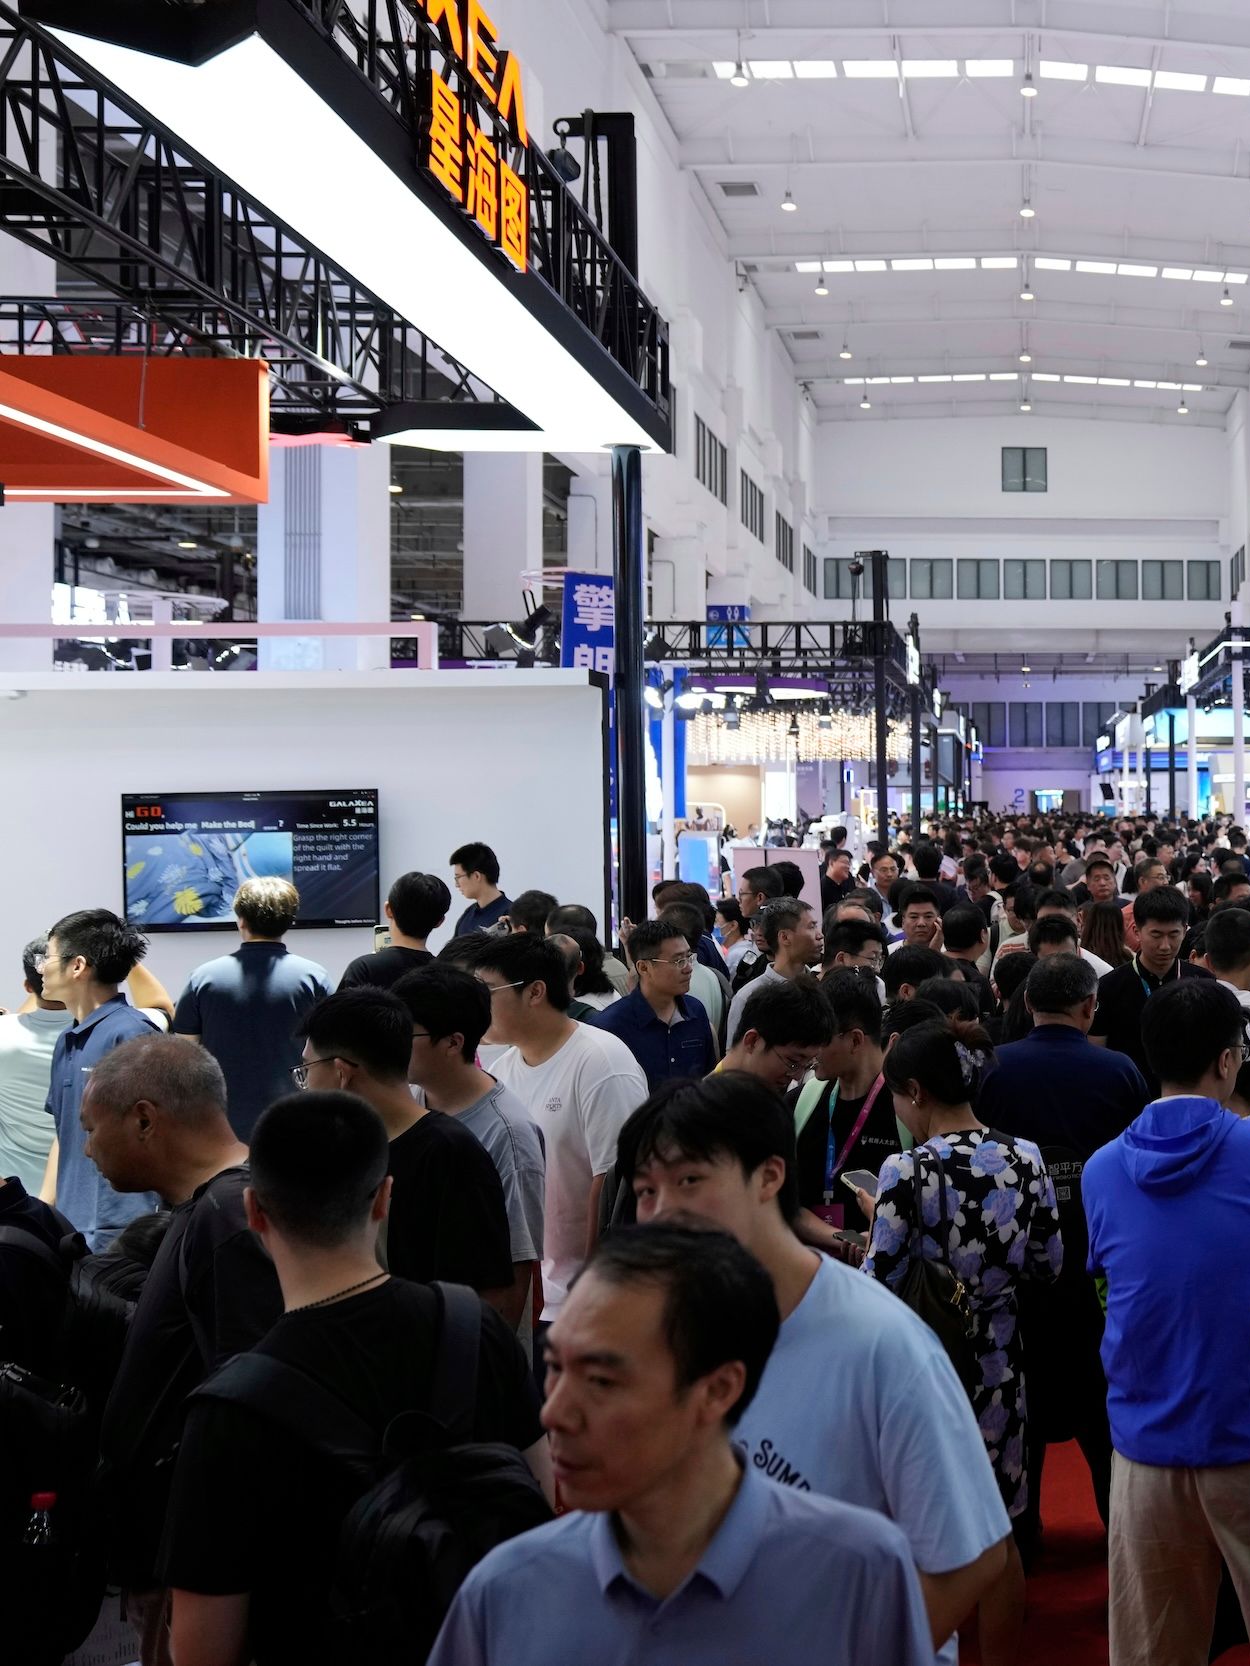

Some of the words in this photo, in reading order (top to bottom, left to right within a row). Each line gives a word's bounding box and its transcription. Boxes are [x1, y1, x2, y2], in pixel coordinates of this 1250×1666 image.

[428, 67, 527, 273] 星海图
[1014, 789, 1025, 803] 2
[125, 822, 149, 831] Could
[149, 823, 165, 832] you
[165, 821, 184, 830] help
[201, 821, 223, 829] Make
[223, 820, 237, 829] the
[342, 818, 357, 828] 5.5
[293, 834, 315, 842] Grasp
[329, 833, 347, 842] right
[302, 843, 315, 851] the
[316, 843, 333, 852] quilt
[352, 842, 365, 850] the
[293, 854, 312, 863] right
[312, 853, 332, 861] hand
[293, 864, 319, 872] spread
[1047, 1161, 1083, 1176] 智平方
